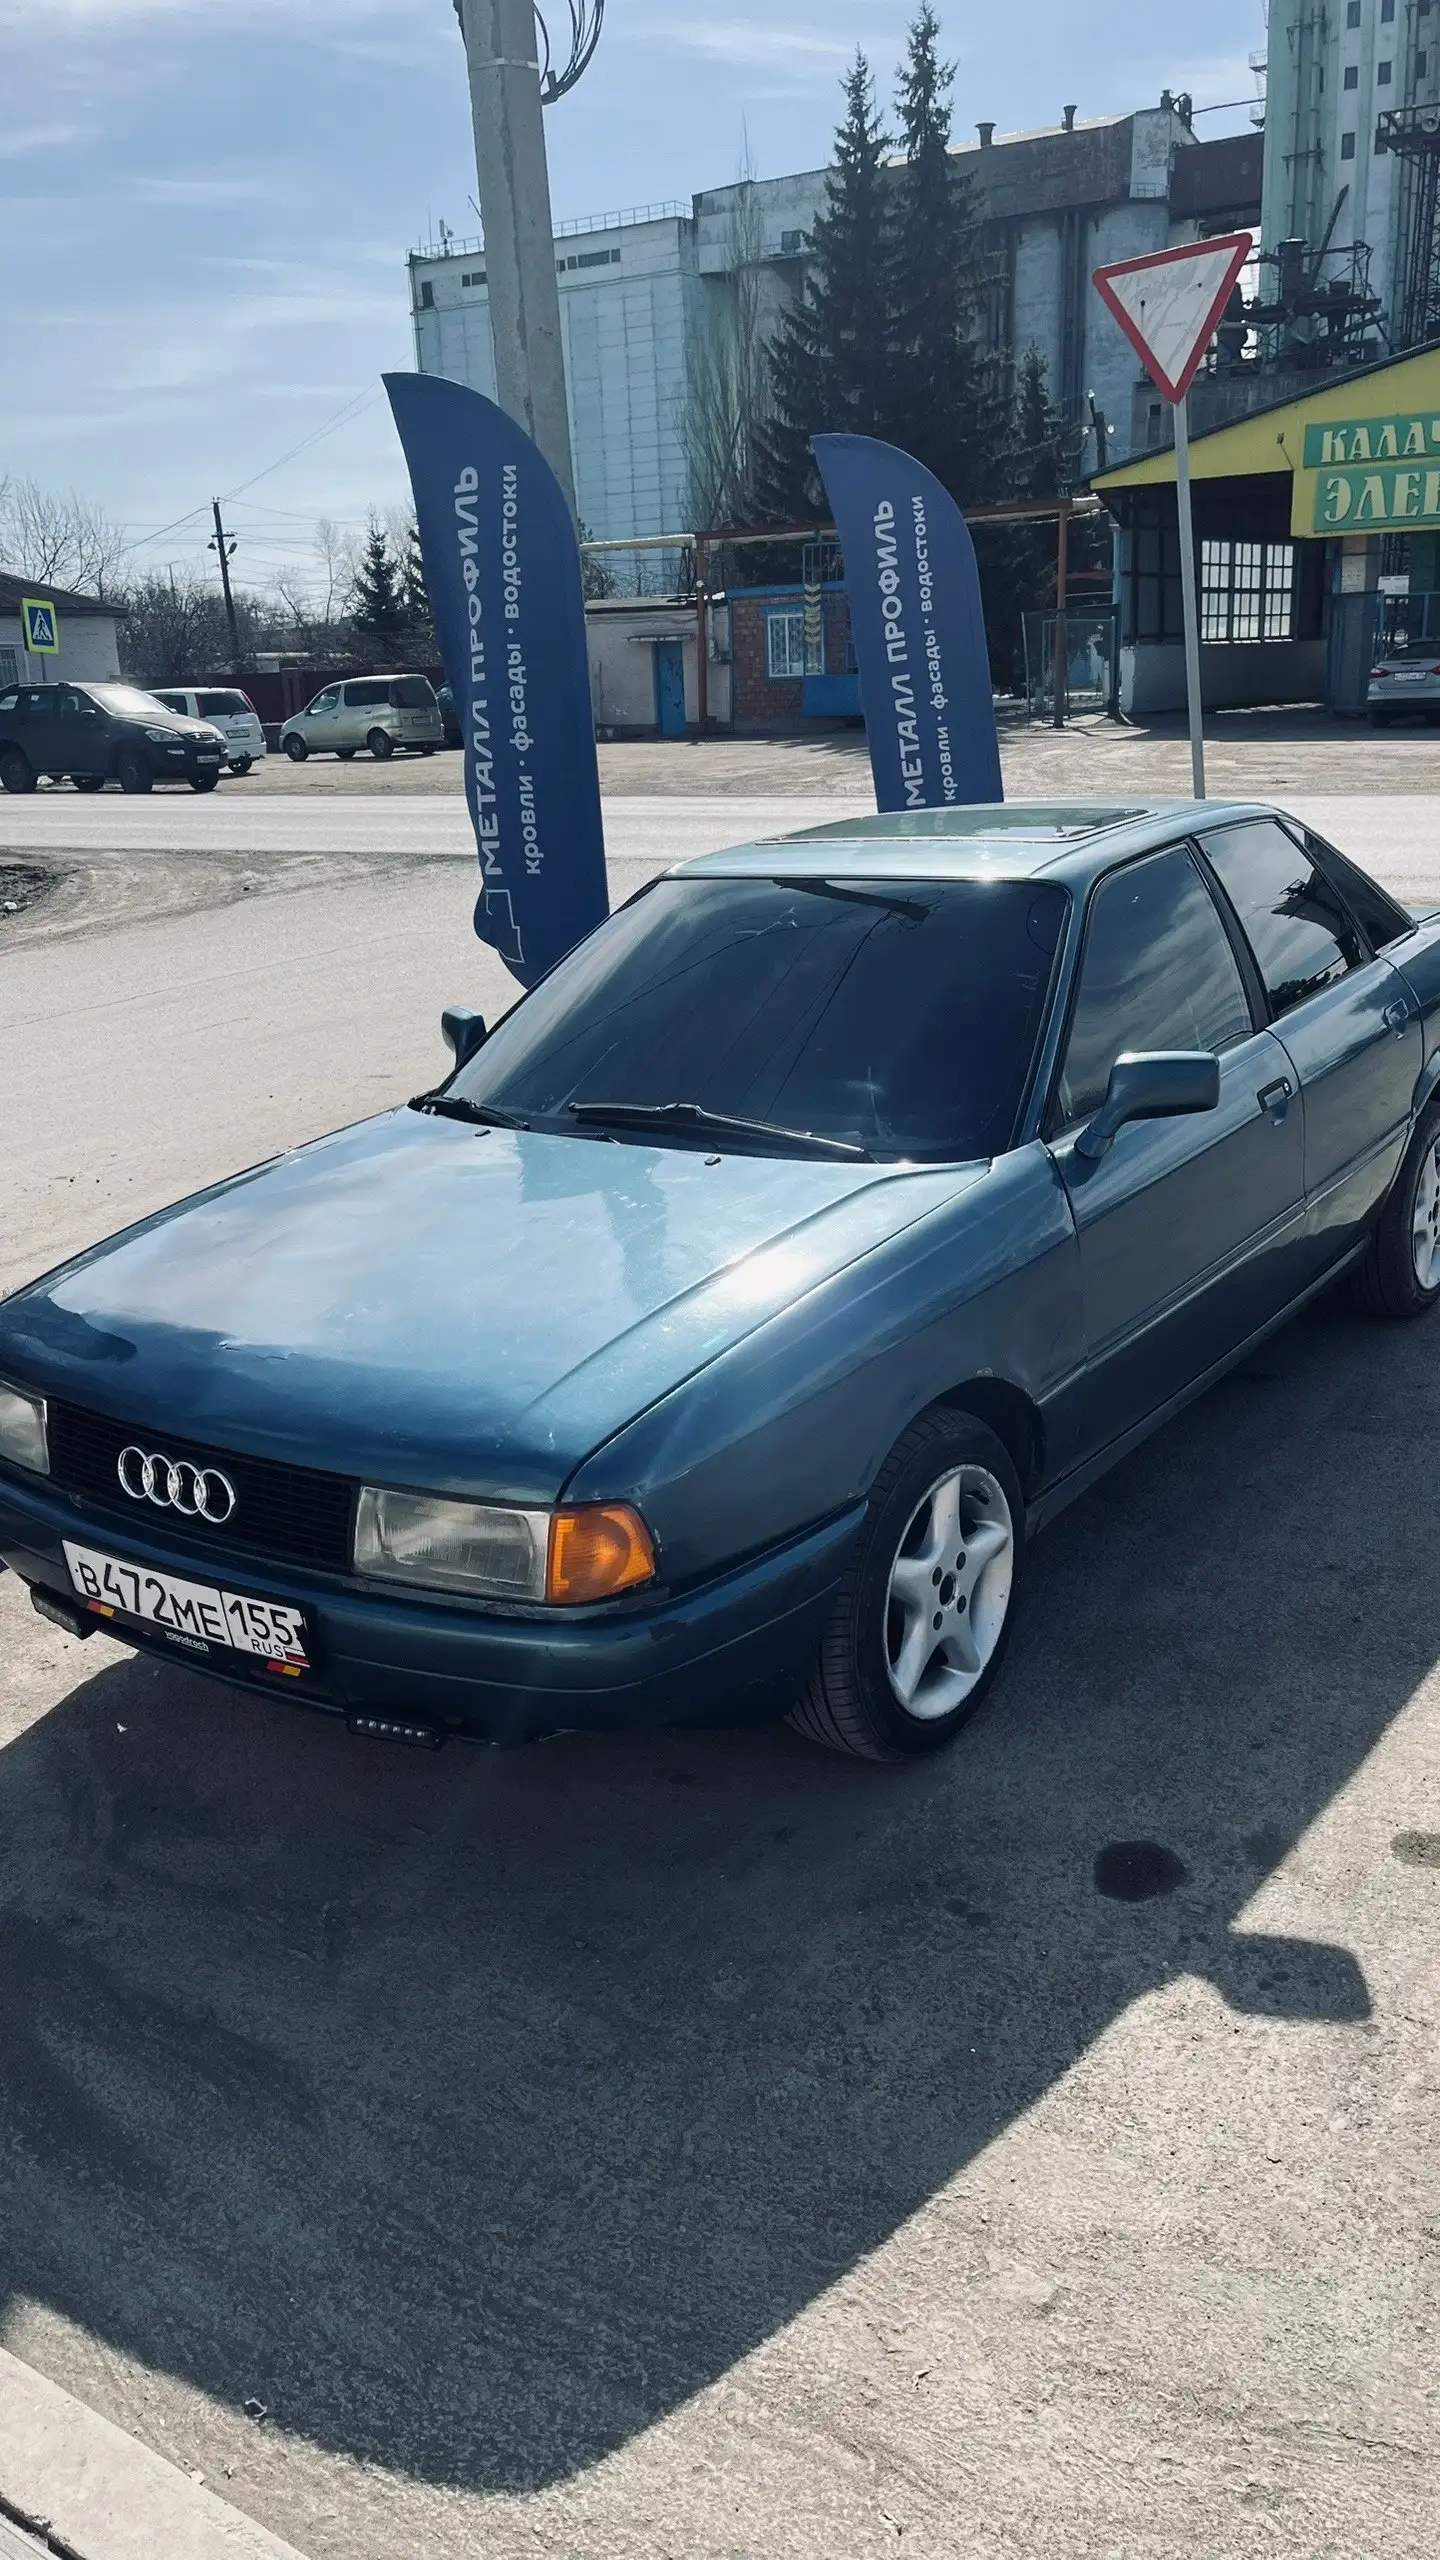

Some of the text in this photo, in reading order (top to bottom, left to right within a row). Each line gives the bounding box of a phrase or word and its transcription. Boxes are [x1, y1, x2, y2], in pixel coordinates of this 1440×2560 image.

[454, 465, 503, 876] МЕТАЛЛ ПРОФИЛЬ
[502, 464, 544, 875] кровли фасады водостоки
[873, 500, 926, 807] МЕТАЛЛ ПРОФИЛЬ
[911, 495, 958, 801] кровли фасады водостоки
[228, 1600, 293, 1646] 155
[251, 1638, 284, 1658] RUS
